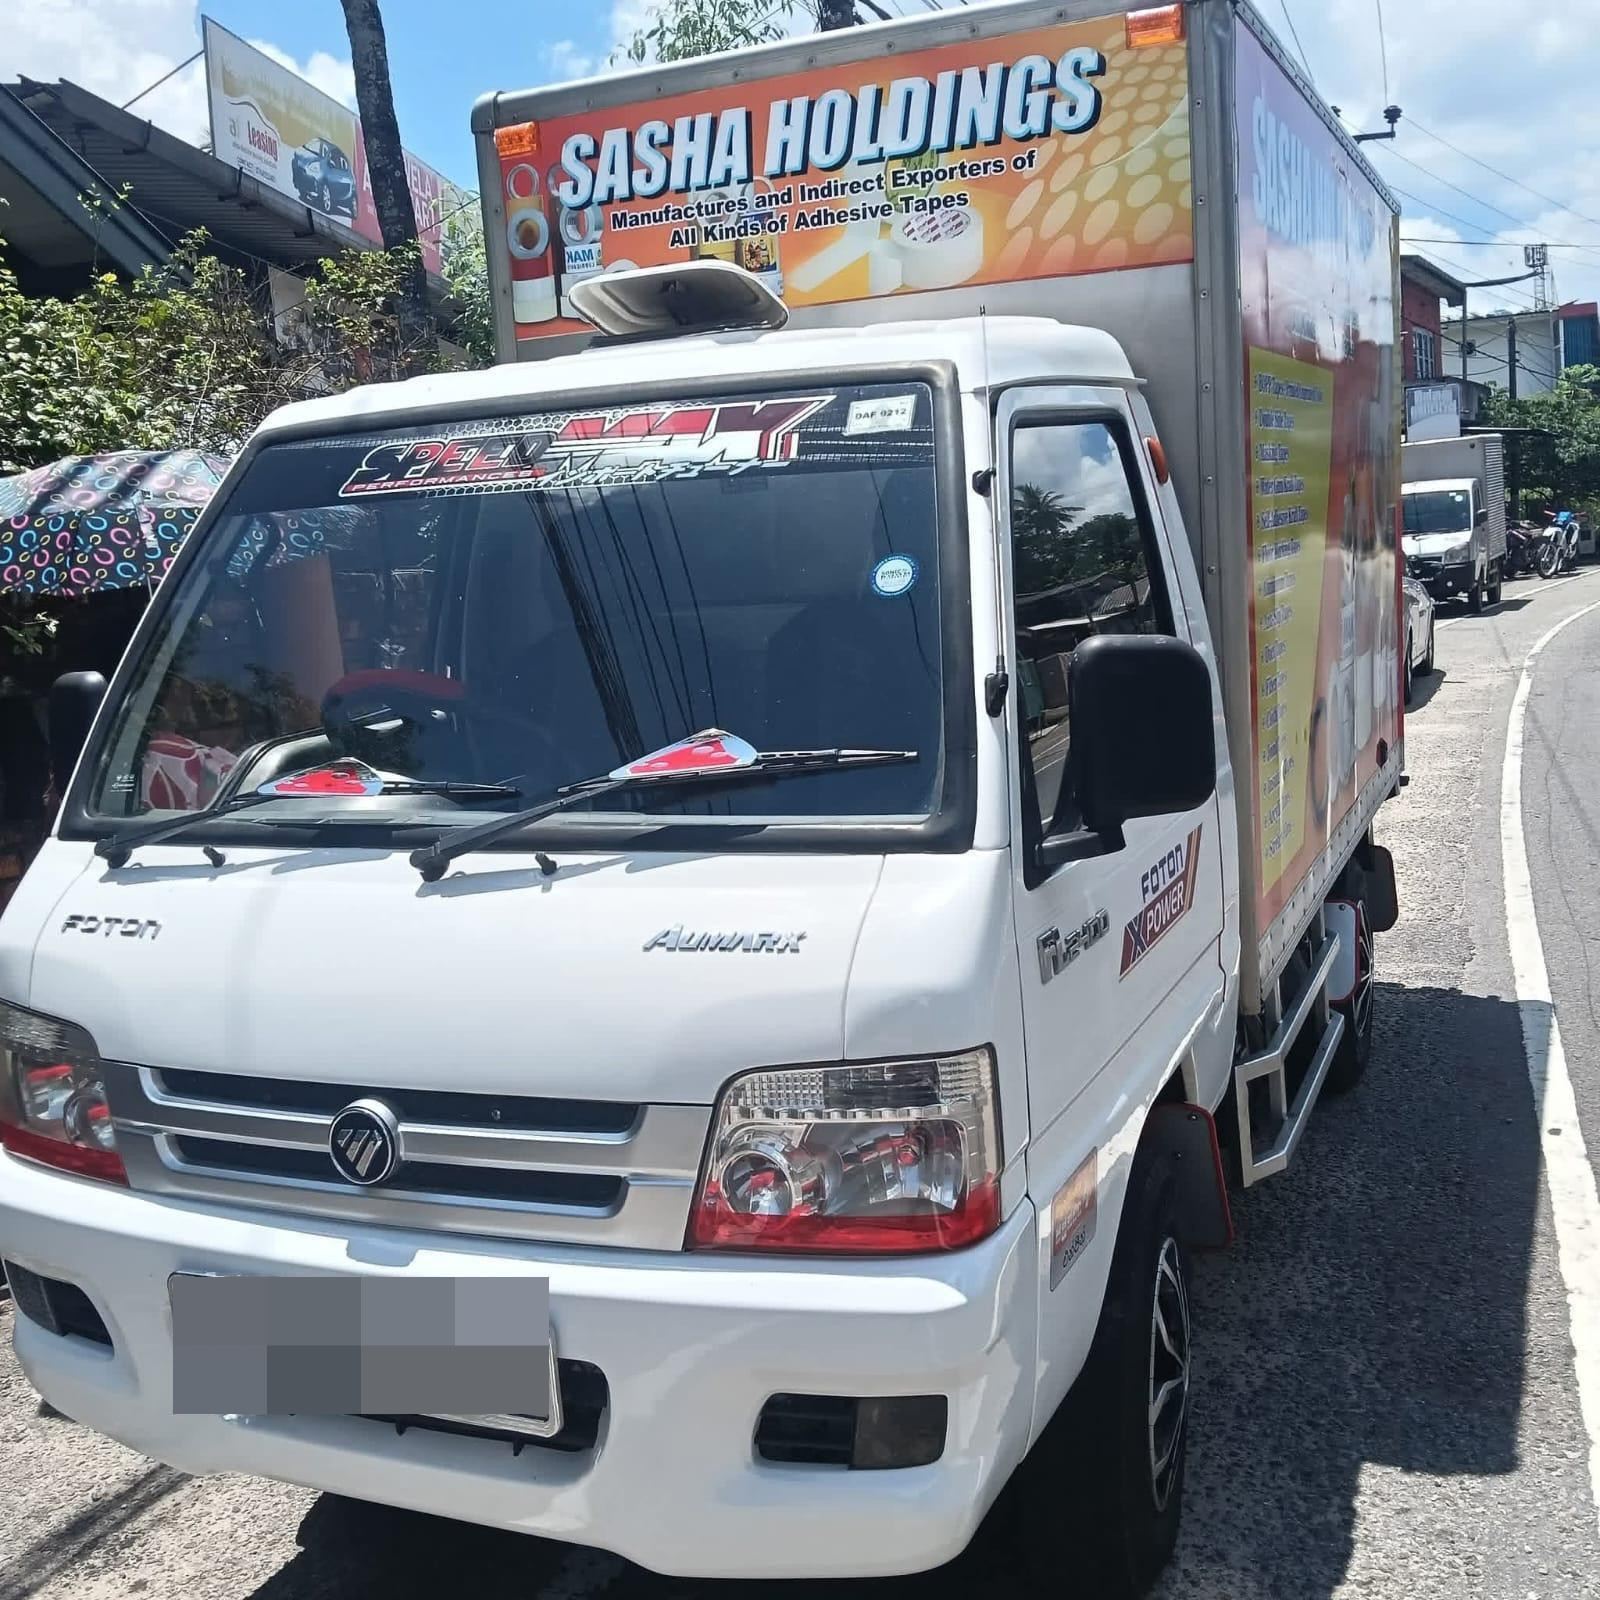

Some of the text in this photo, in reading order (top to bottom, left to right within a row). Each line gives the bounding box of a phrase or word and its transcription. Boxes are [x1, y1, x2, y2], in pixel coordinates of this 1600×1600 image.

[247, 120, 279, 162] Leasing
[559, 47, 1104, 210] SASHA HOLDINGS
[611, 150, 1037, 229] Manufactures and Indirect Exporters of
[670, 192, 969, 247] All Kinds of Adhesive Tapes
[855, 411, 877, 420] DAF
[351, 469, 534, 493] PERFORMANCES
[1141, 843, 1184, 904] FOTON
[61, 914, 162, 941] FOTON
[1146, 879, 1185, 942] POWER
